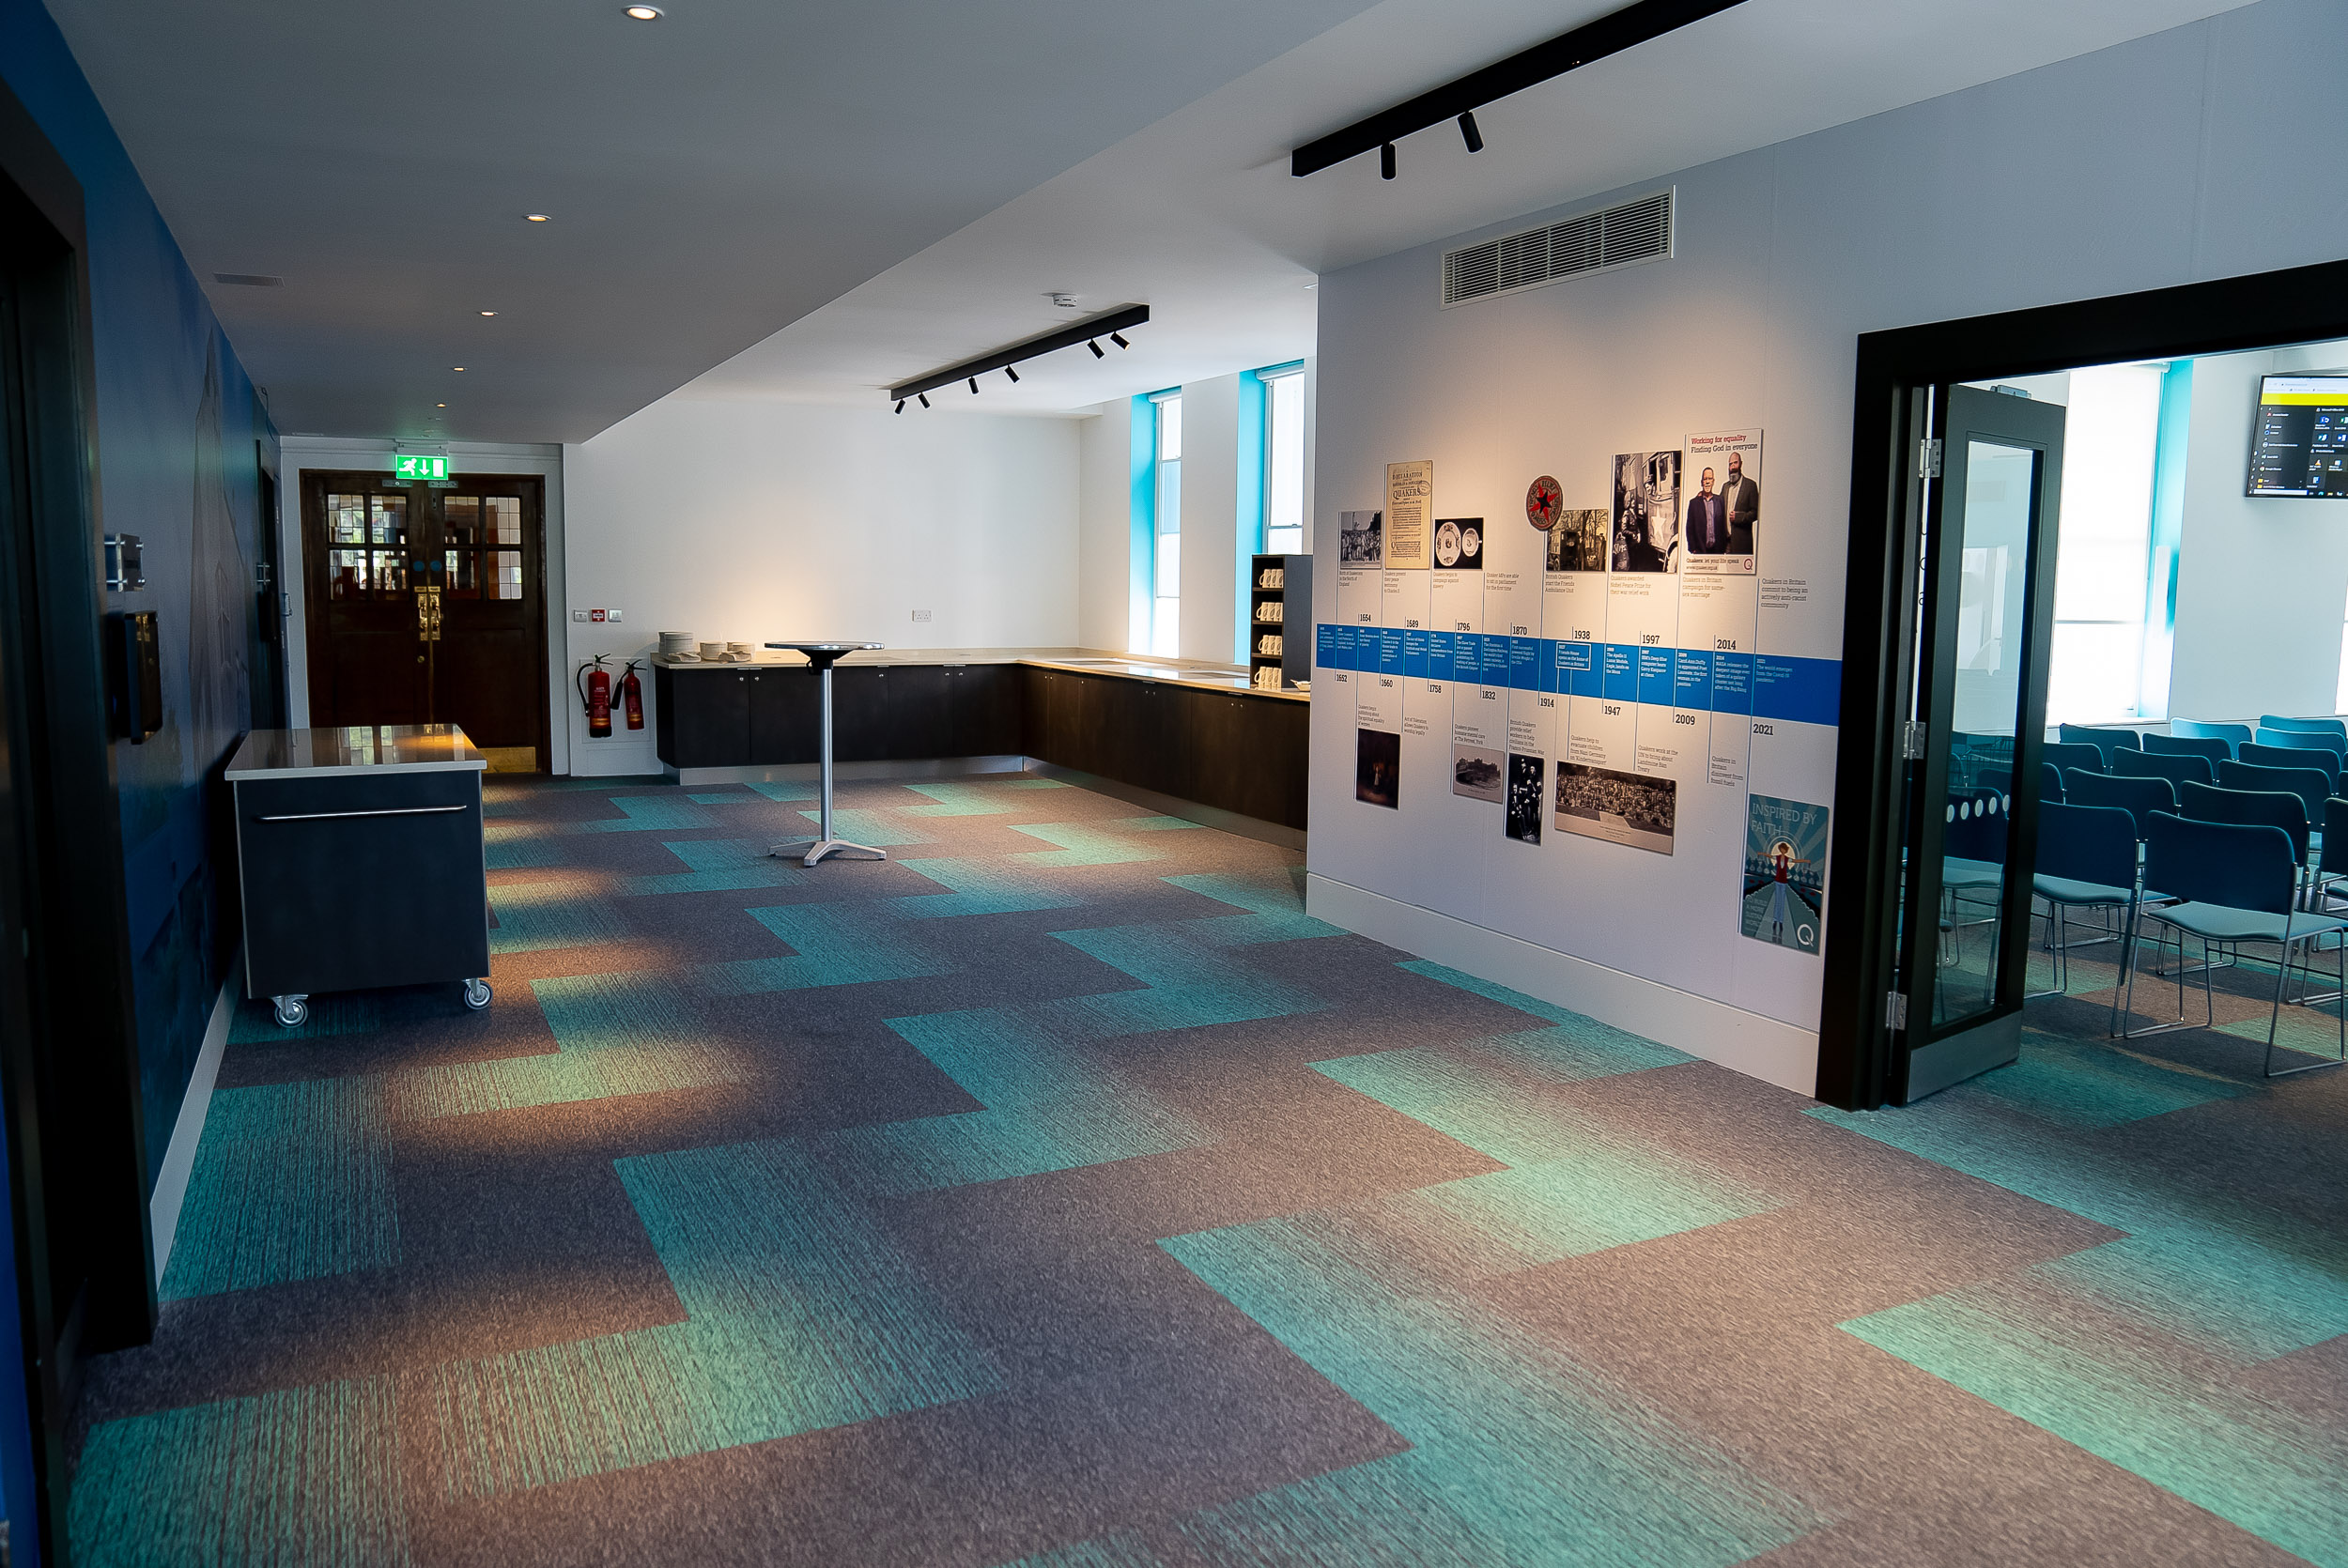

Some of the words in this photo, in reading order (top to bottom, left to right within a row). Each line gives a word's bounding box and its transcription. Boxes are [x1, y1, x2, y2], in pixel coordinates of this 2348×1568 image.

[1723, 434, 1747, 443] equality
[1393, 487, 1421, 500] QUAKERS
[1743, 558, 1753, 570] Q
[1406, 620, 1418, 628] 1689
[1512, 625, 1527, 635] 1870
[1574, 630, 1590, 639] 1938
[1642, 635, 1660, 644] 1997
[1717, 639, 1737, 650] 2014
[1336, 674, 1347, 683] 1652
[1382, 679, 1393, 687] 1660
[1429, 684, 1442, 694] 1758
[1482, 690, 1495, 700] 1832
[1540, 698, 1554, 708] 1914
[1604, 706, 1621, 715] 1947
[1676, 714, 1695, 725] 2009
[1753, 723, 1773, 735] 2021
[1753, 803, 1800, 822] INSPIRED
[1802, 811, 1817, 825] BY
[1751, 820, 1782, 836] FAITH
[1798, 924, 1814, 946] Q
